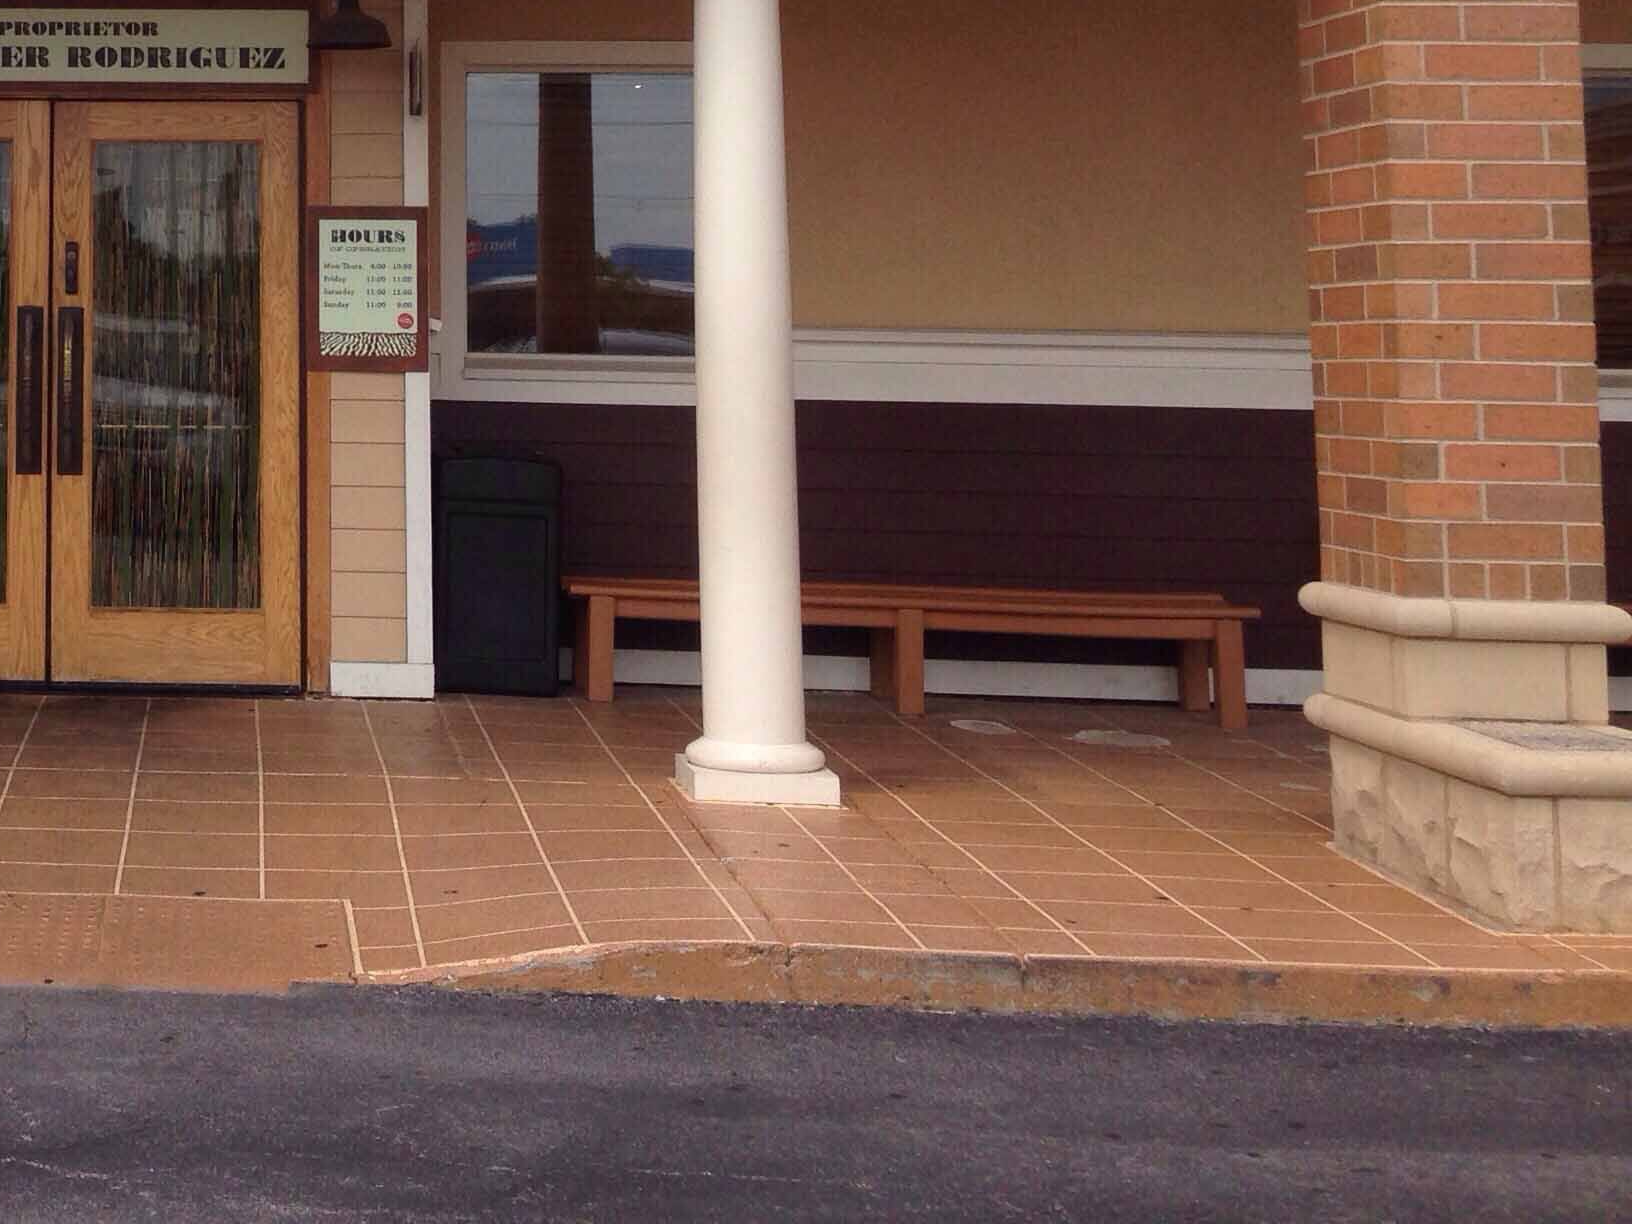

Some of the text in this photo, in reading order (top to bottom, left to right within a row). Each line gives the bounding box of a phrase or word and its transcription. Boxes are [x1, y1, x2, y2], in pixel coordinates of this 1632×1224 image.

[67, 46, 286, 70] RODRIGUEZ
[331, 229, 406, 243] HOURS
[323, 276, 347, 284] Friday
[323, 288, 355, 296] Saturday
[323, 301, 350, 309] Sunday
